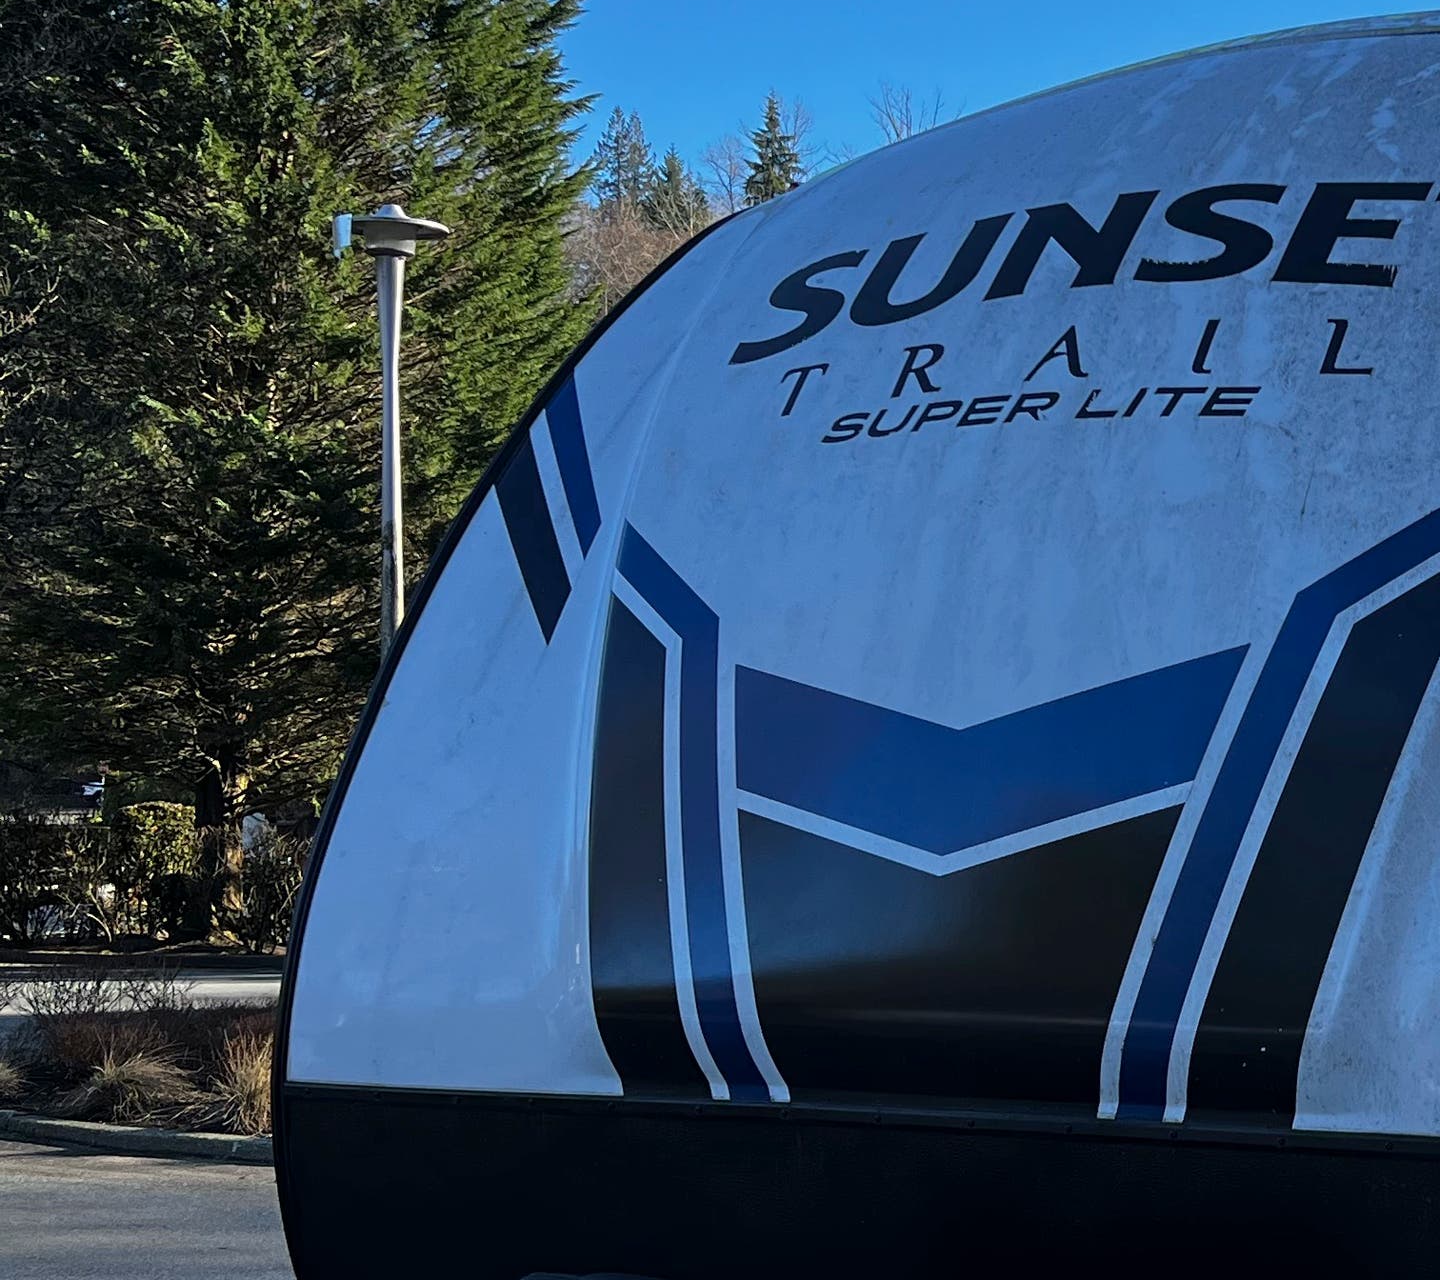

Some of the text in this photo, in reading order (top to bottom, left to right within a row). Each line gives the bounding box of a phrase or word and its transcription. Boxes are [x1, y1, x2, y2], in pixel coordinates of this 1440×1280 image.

[780, 318, 1374, 417] TRAIL
[821, 385, 1262, 444] SUPER LITE
